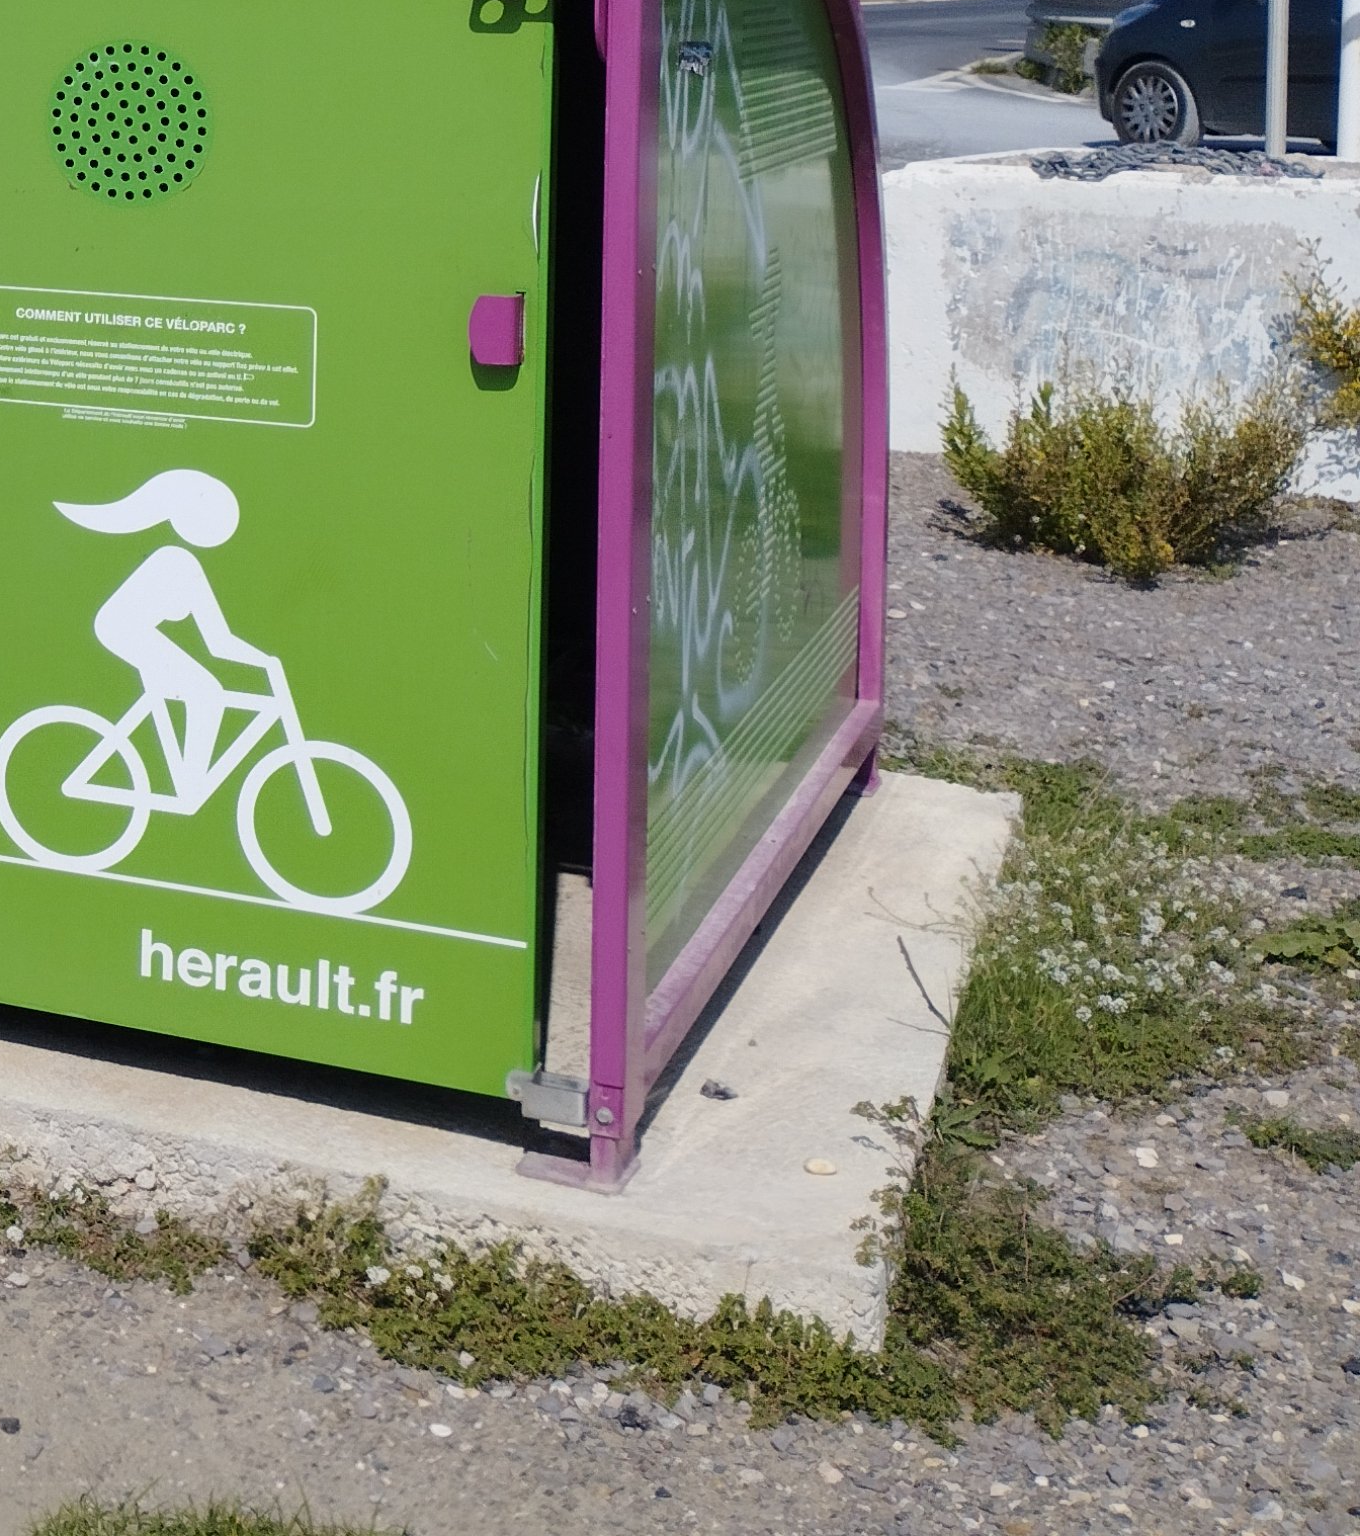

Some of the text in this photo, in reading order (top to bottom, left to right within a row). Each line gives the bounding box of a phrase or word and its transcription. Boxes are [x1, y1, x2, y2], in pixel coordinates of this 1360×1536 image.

[16, 307, 247, 335] COMMENT UTILISER CE VÉLOPARC ?
[140, 928, 424, 1025] herault.fr
